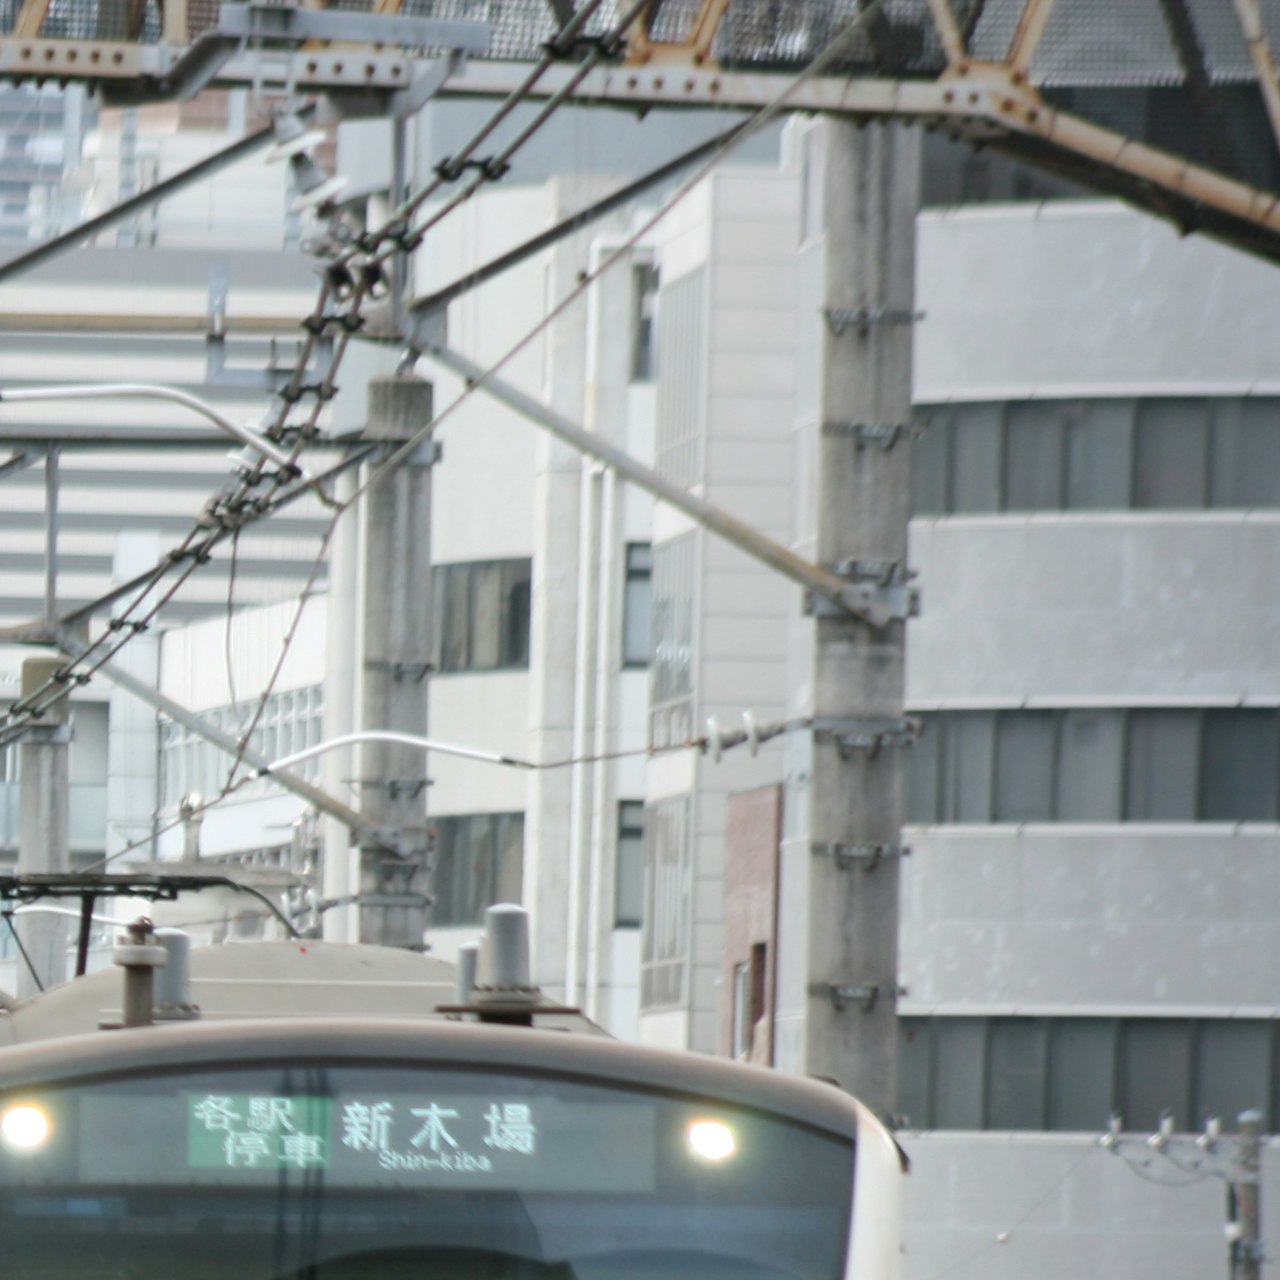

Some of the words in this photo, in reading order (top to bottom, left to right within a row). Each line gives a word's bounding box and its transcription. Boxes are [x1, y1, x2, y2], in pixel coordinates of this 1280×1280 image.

[194, 1095, 297, 1132] 各駅
[342, 1101, 536, 1153] 新木場
[223, 1131, 325, 1166] 停車
[378, 1149, 493, 1173] Shin-kiba
